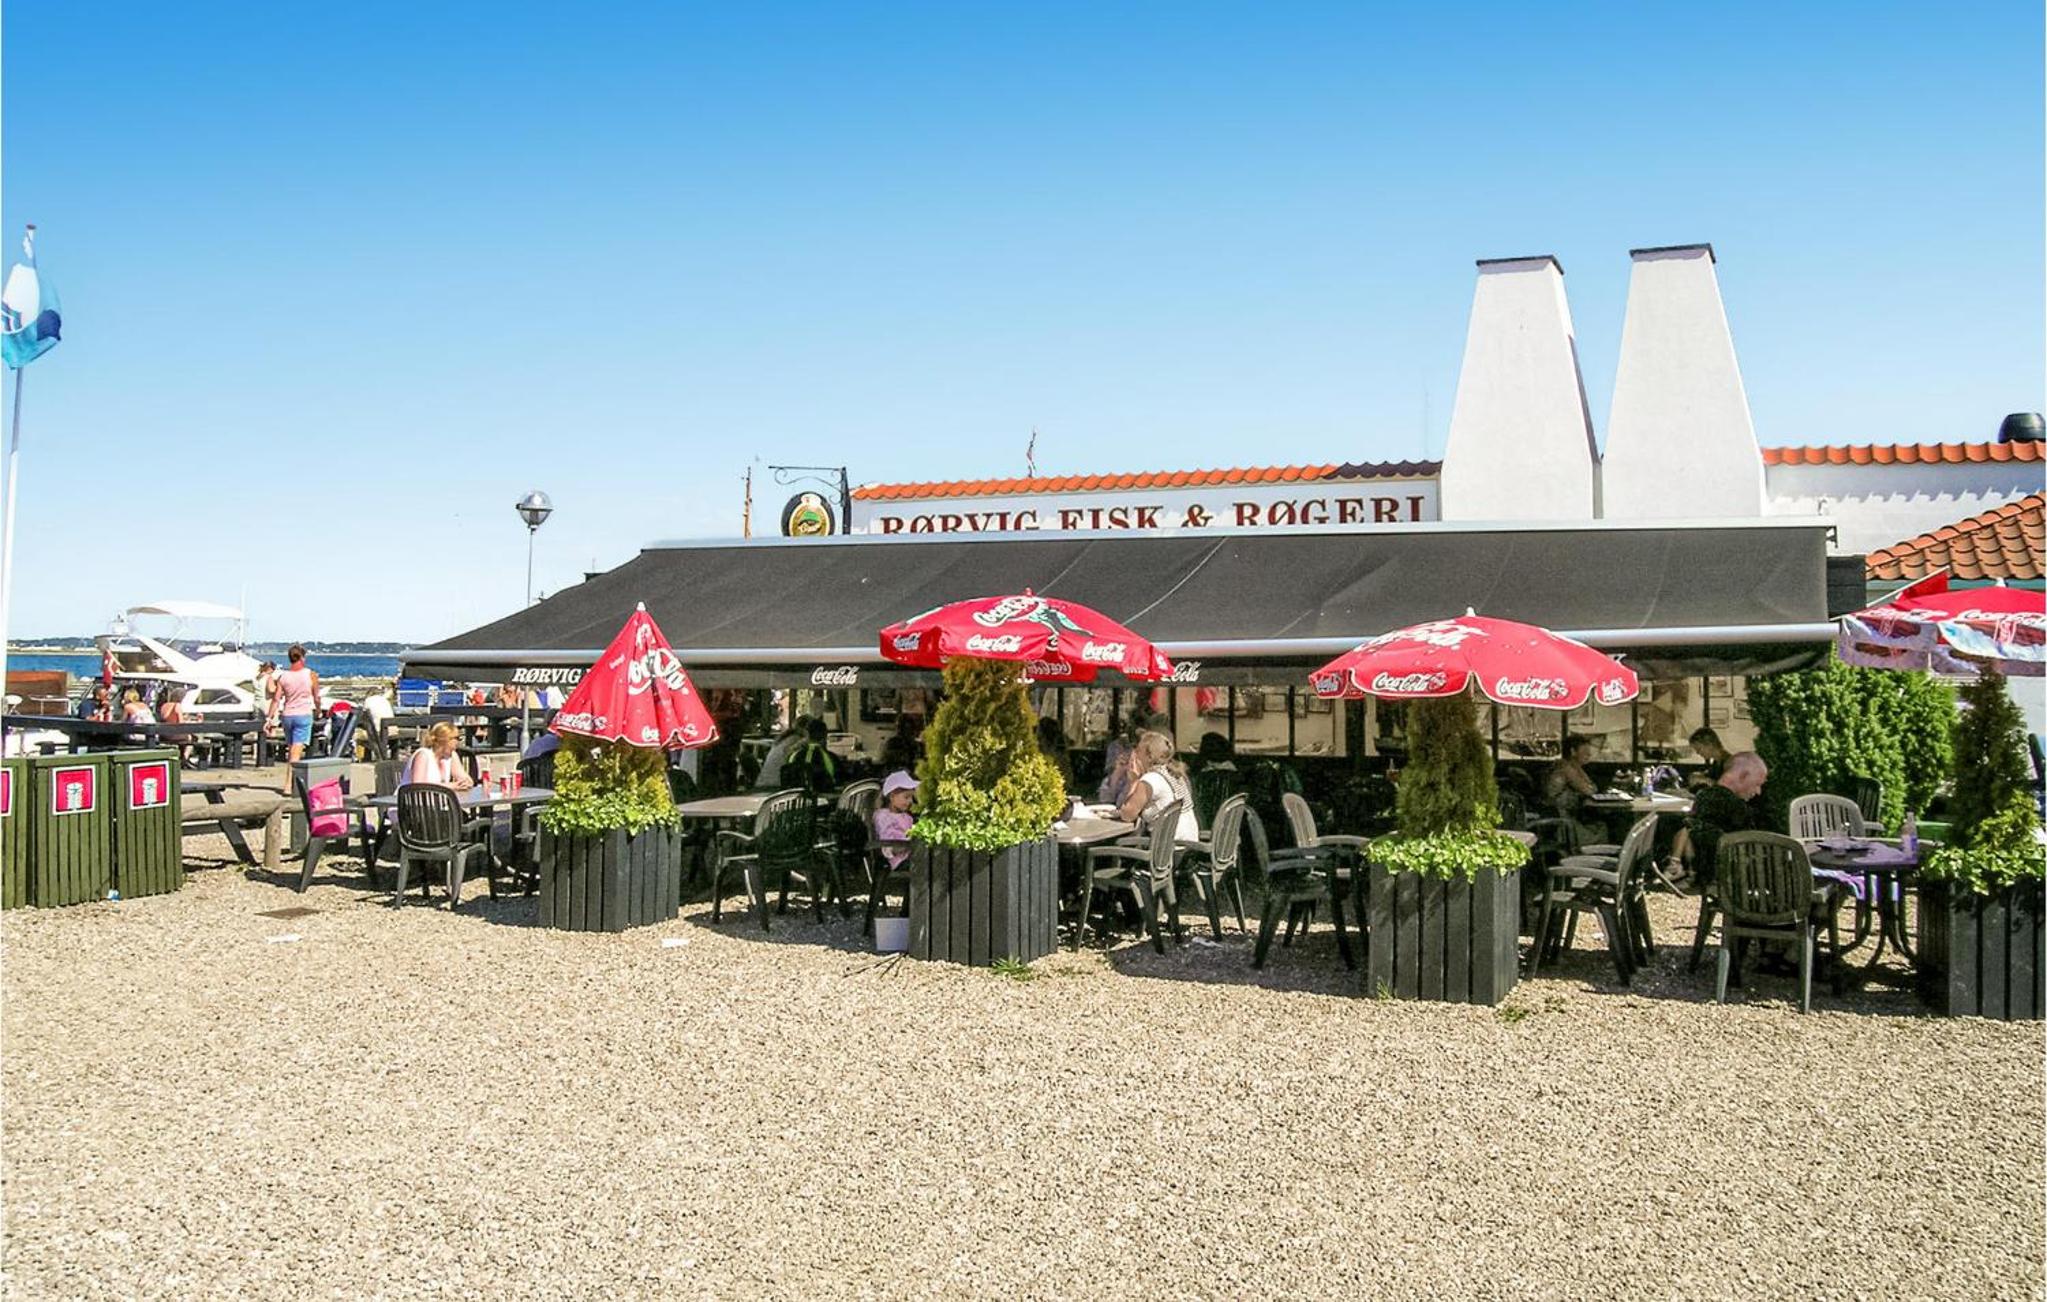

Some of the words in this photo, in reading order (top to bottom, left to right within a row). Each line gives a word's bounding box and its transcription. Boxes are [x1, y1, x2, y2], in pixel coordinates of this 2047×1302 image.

[880, 509, 1040, 534] RØRVIG
[1058, 505, 1166, 530] FISK
[1181, 504, 1214, 528] &
[1232, 496, 1425, 526] RØGERI
[511, 667, 582, 684] RØRVIG
[811, 665, 860, 685] Coca-Cola
[1371, 672, 1429, 692] Coca-Cola
[1495, 676, 1551, 701] Coca-Cola
